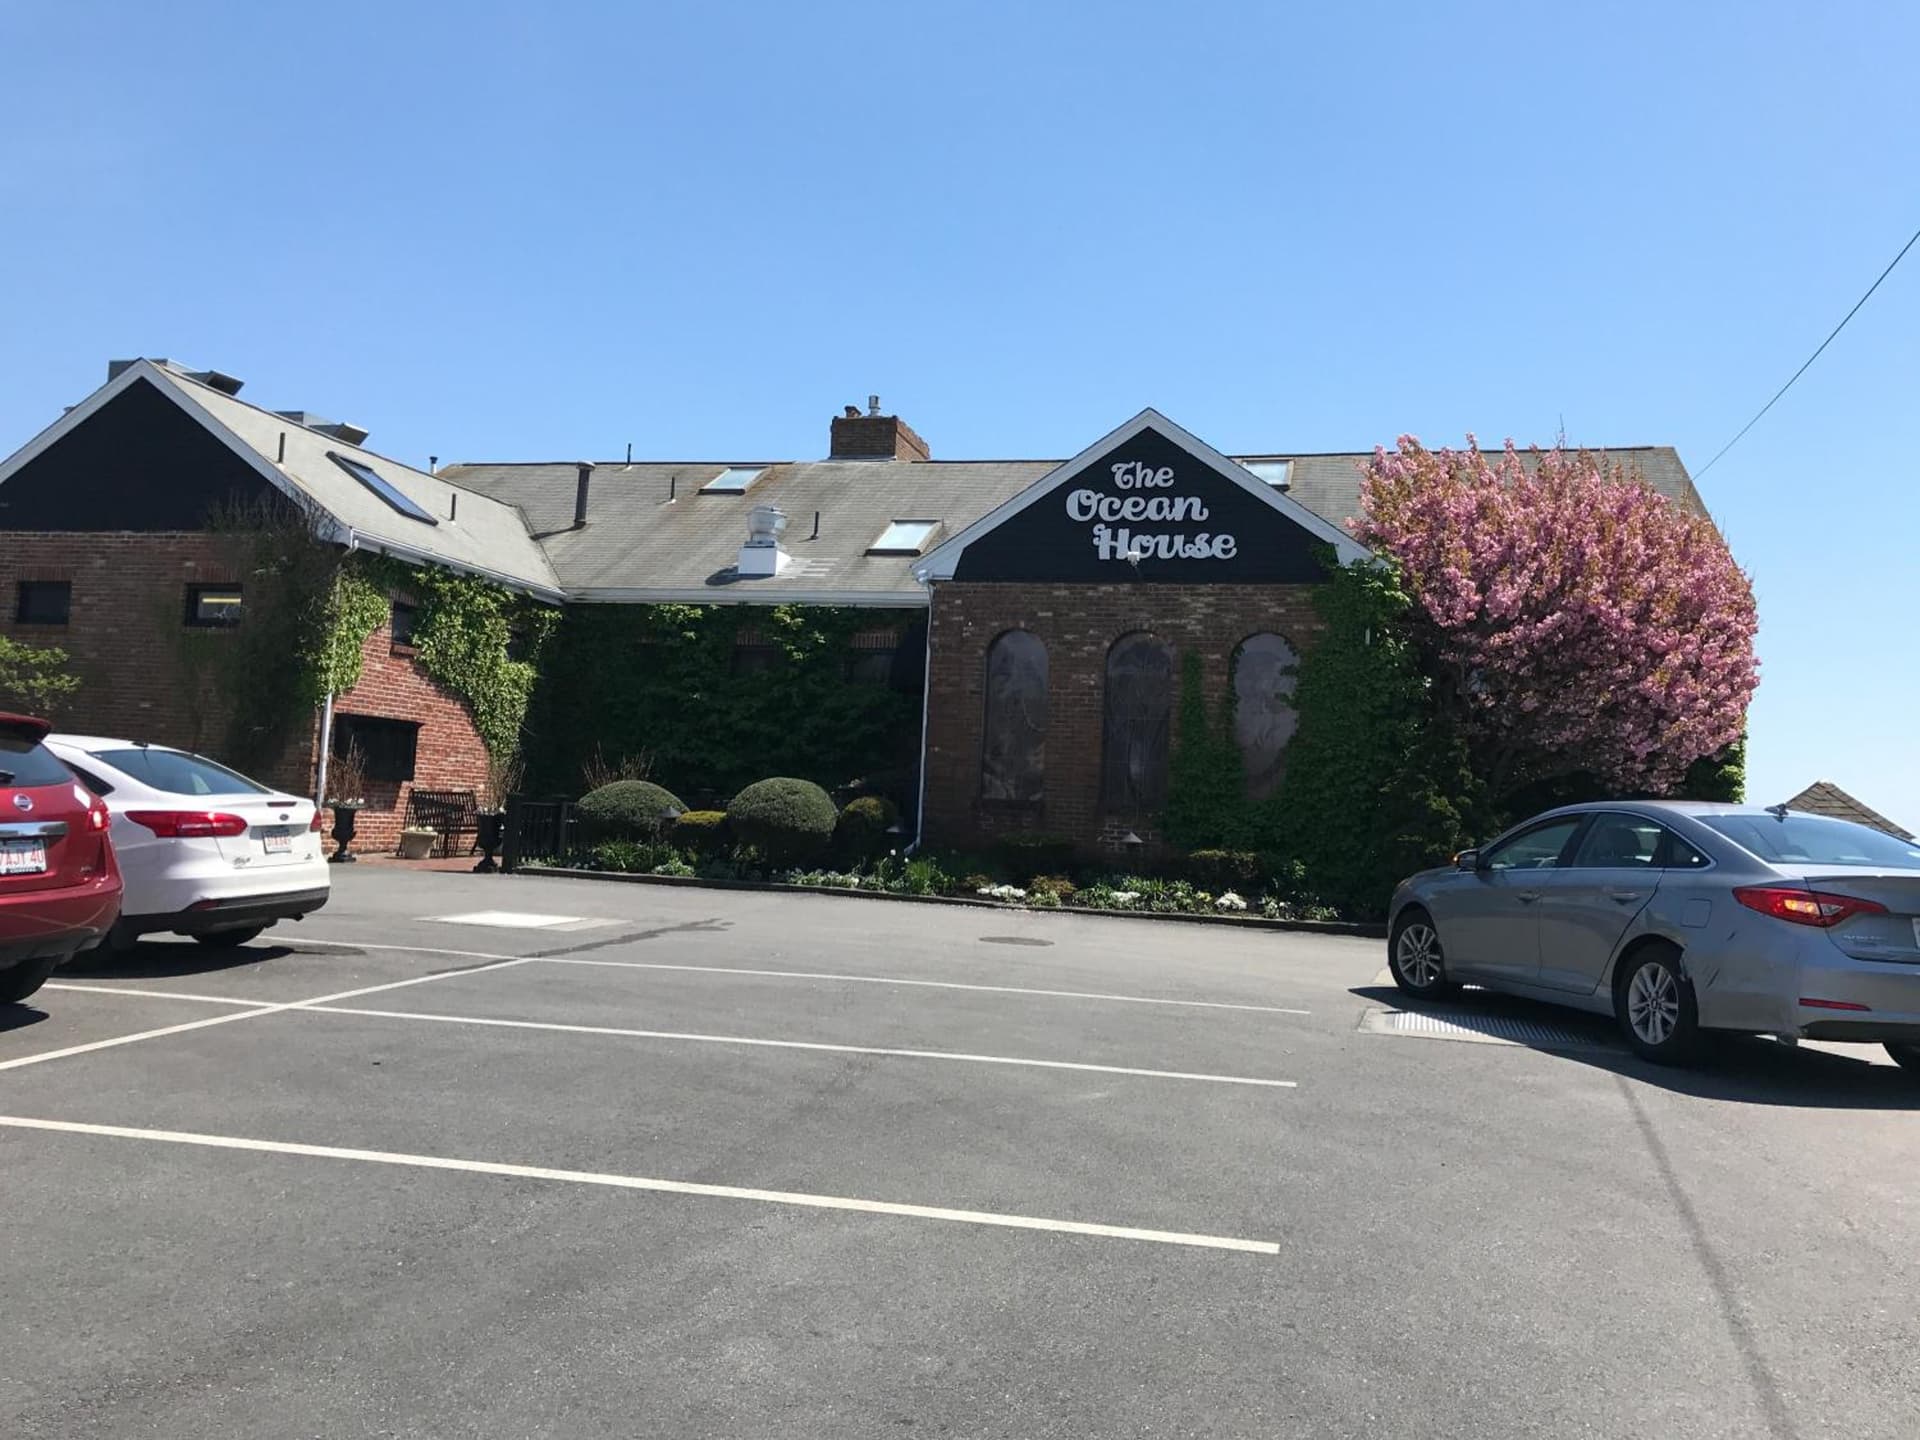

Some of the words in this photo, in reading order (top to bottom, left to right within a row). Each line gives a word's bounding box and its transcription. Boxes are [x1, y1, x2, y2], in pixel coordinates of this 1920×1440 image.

[1111, 461, 1175, 489] The
[1066, 489, 1209, 521] Ocean
[1093, 523, 1237, 560] House
